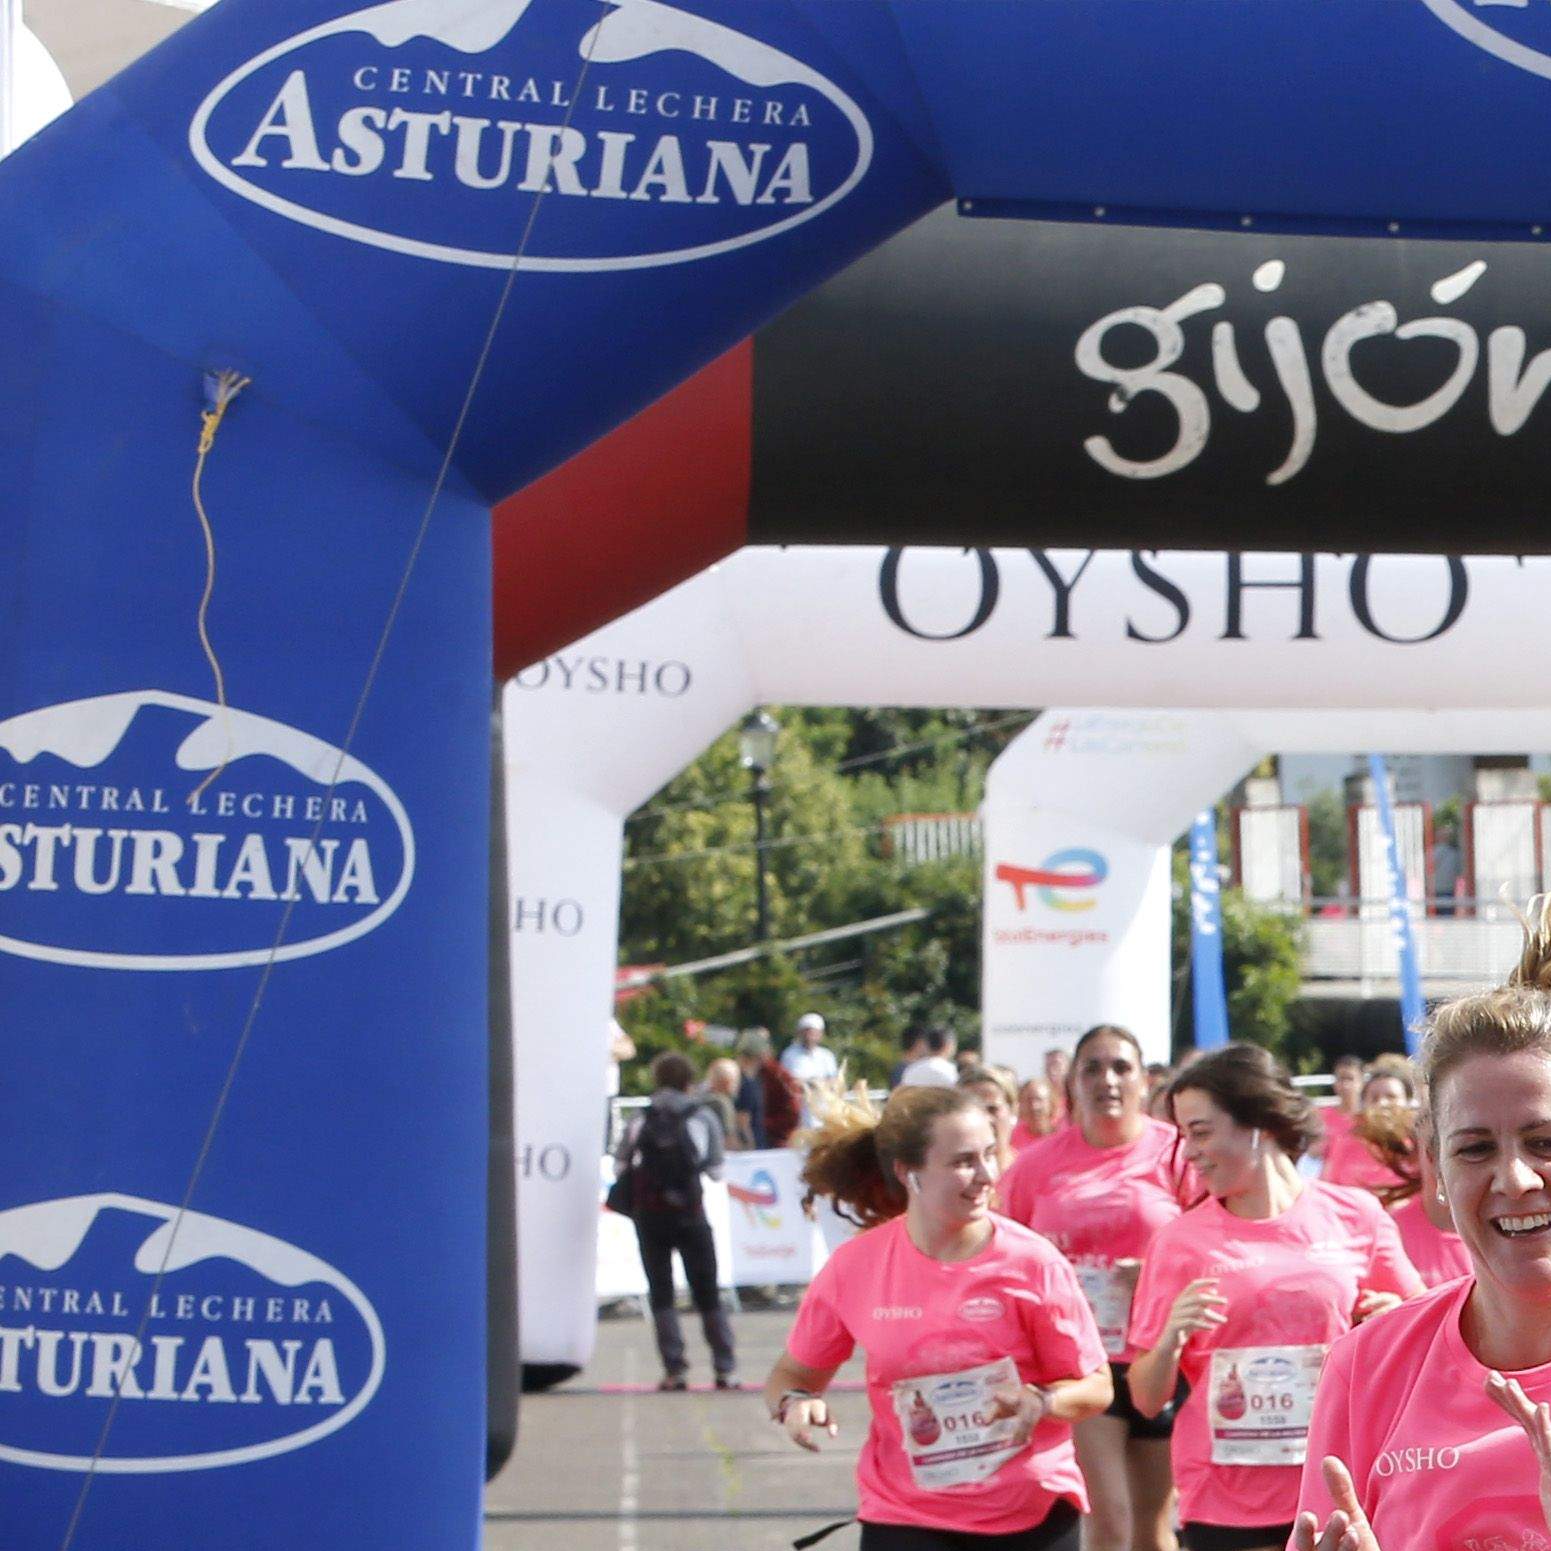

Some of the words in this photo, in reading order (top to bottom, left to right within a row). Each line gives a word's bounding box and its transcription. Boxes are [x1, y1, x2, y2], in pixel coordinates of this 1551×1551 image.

[354, 66, 571, 108] CENTRAL
[597, 84, 814, 127] LECHERA
[232, 69, 816, 206] ASTURIANA
[878, 547, 1471, 645] OYSHO
[0, 781, 171, 814] CENTRAL
[190, 791, 370, 824] LECHERA
[0, 823, 380, 906] STURIANA
[0, 1286, 129, 1317] NTRAL
[149, 1293, 335, 1324] LECHERA
[0, 1326, 346, 1406] TURIANA
[944, 1411, 986, 1433] 016
[1250, 1392, 1294, 1411] 016
[1374, 1445, 1461, 1478] OYSHO
